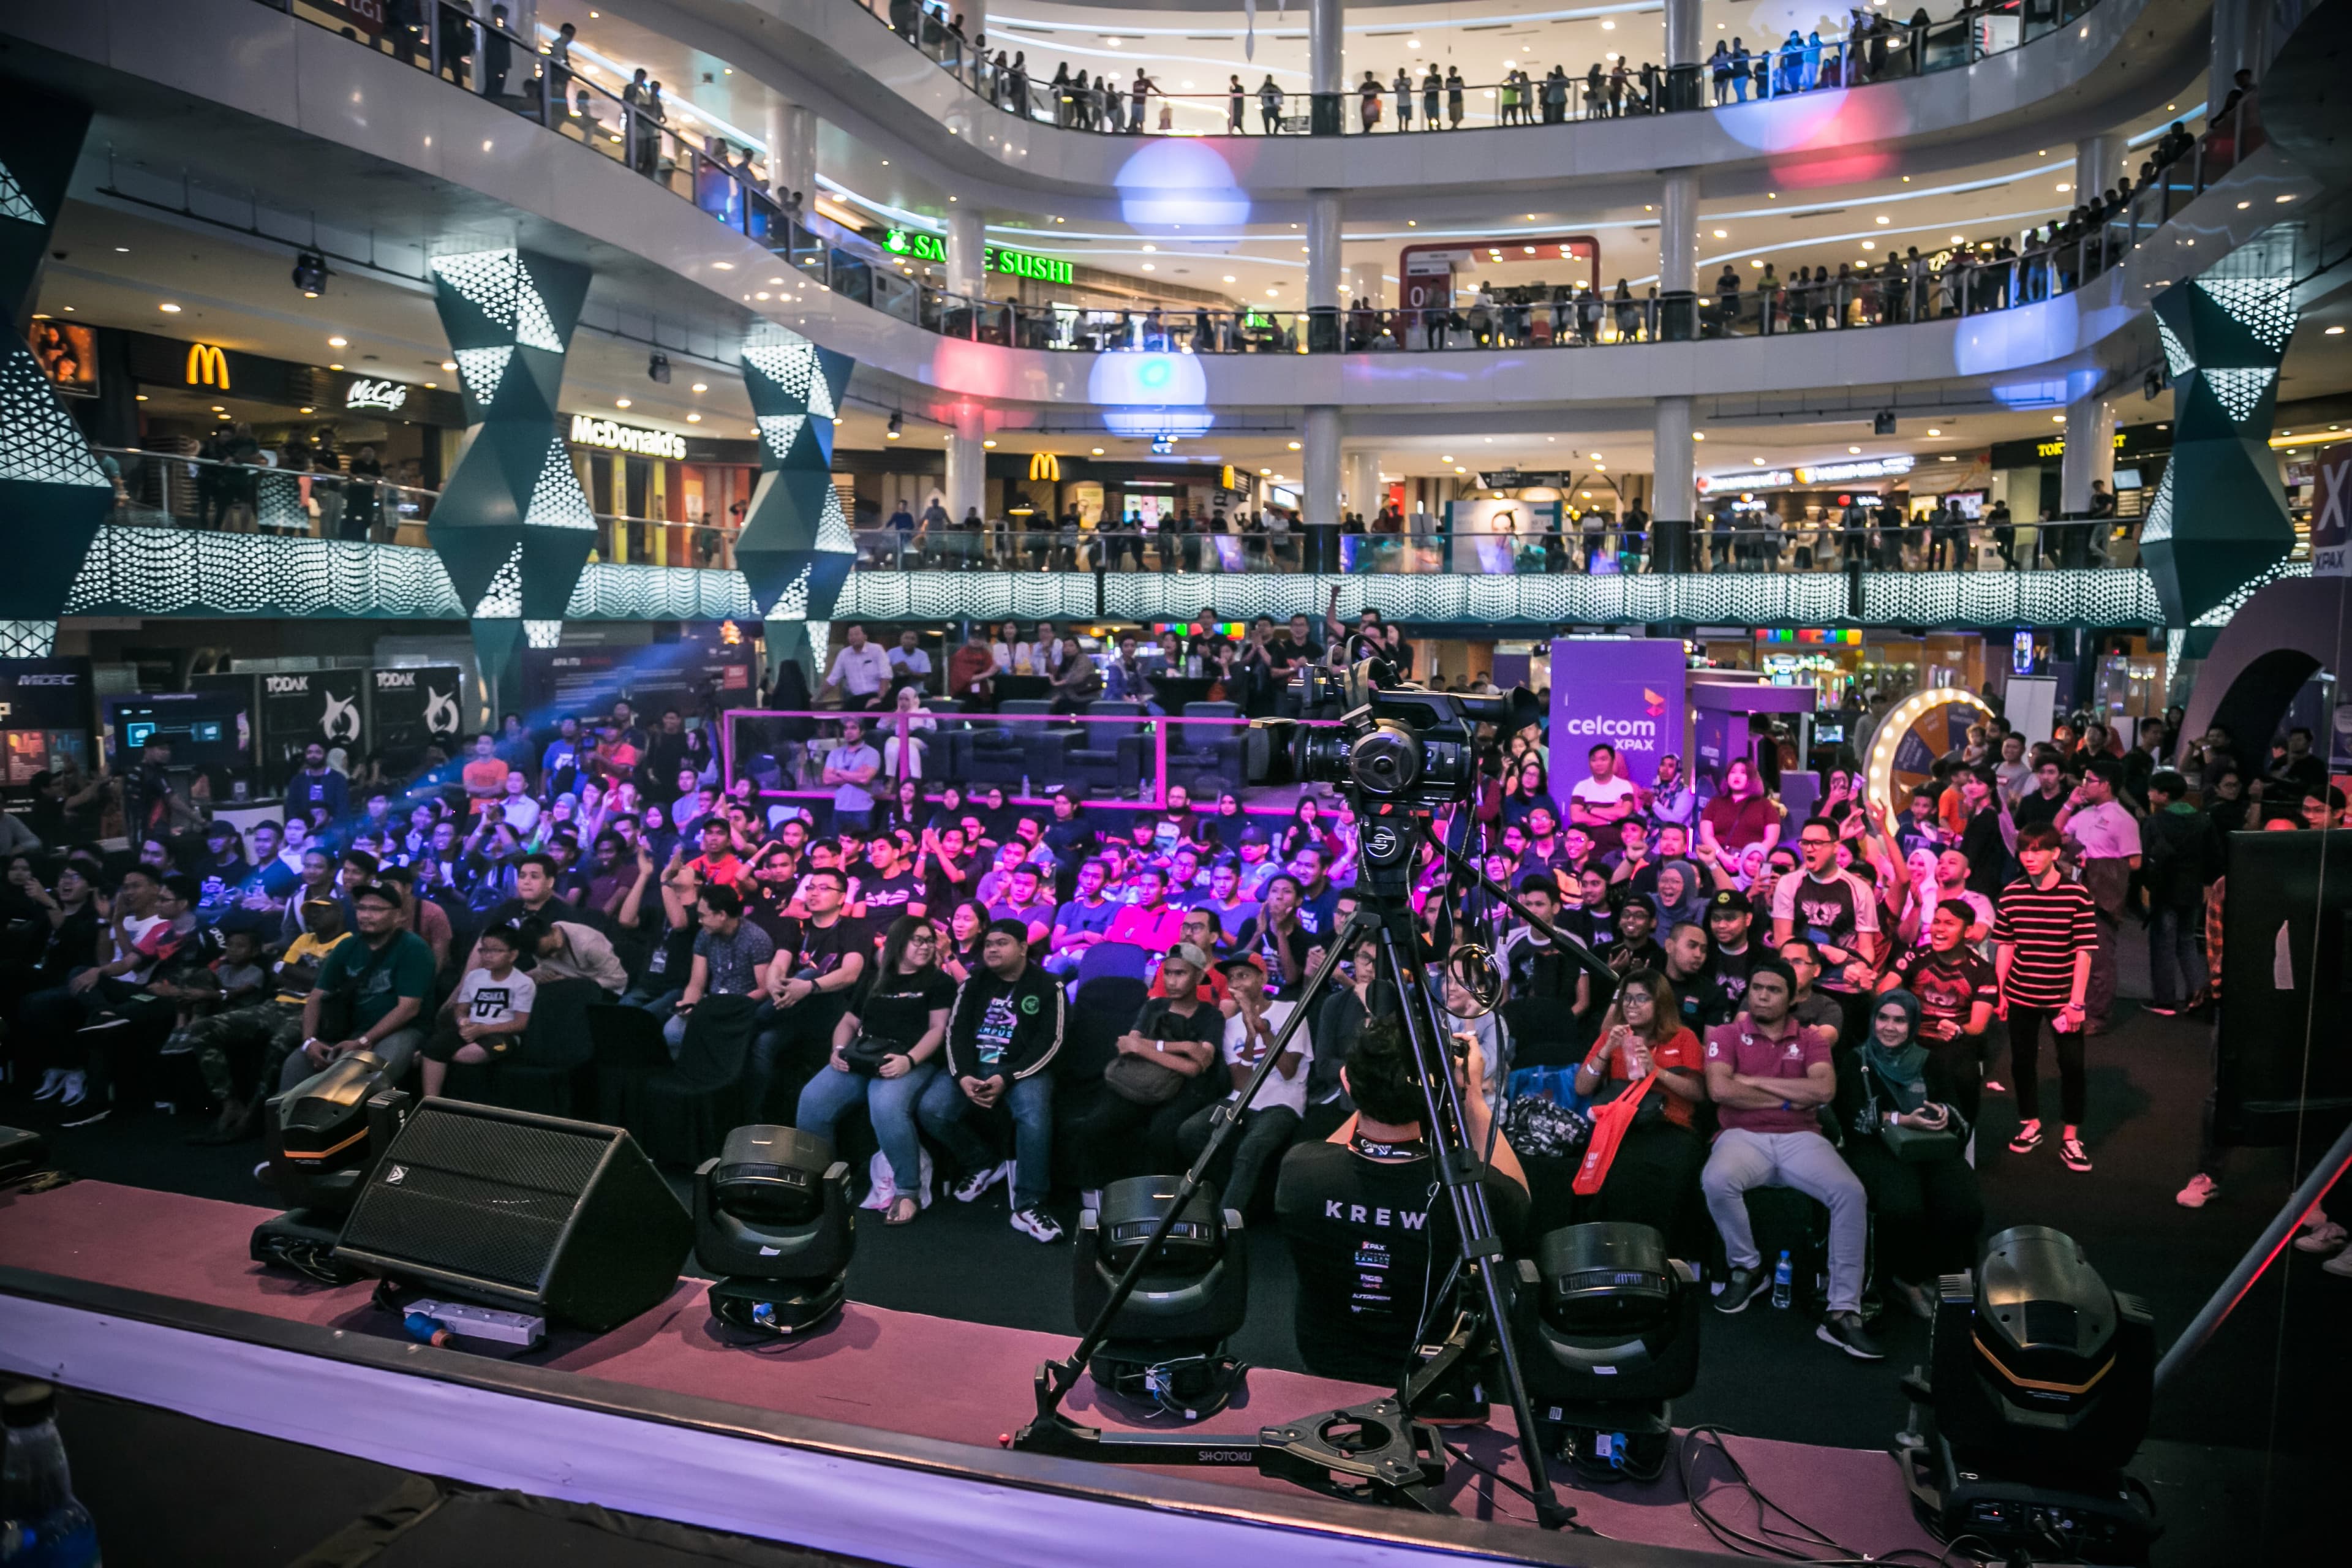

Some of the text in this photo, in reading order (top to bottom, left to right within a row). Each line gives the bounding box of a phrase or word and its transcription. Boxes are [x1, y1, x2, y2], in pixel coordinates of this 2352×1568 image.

[999, 250, 1074, 285] SUSHI
[571, 415, 687, 460] McDonald's
[2314, 550, 2345, 570] XPAX
[266, 676, 309, 692] TODAK
[376, 671, 416, 687] TODAK
[1567, 715, 1656, 736] celcom
[1614, 739, 1654, 751] XPAX
[1325, 1199, 1427, 1231] KREW
[1198, 1451, 1252, 1461] SHOTOKU
